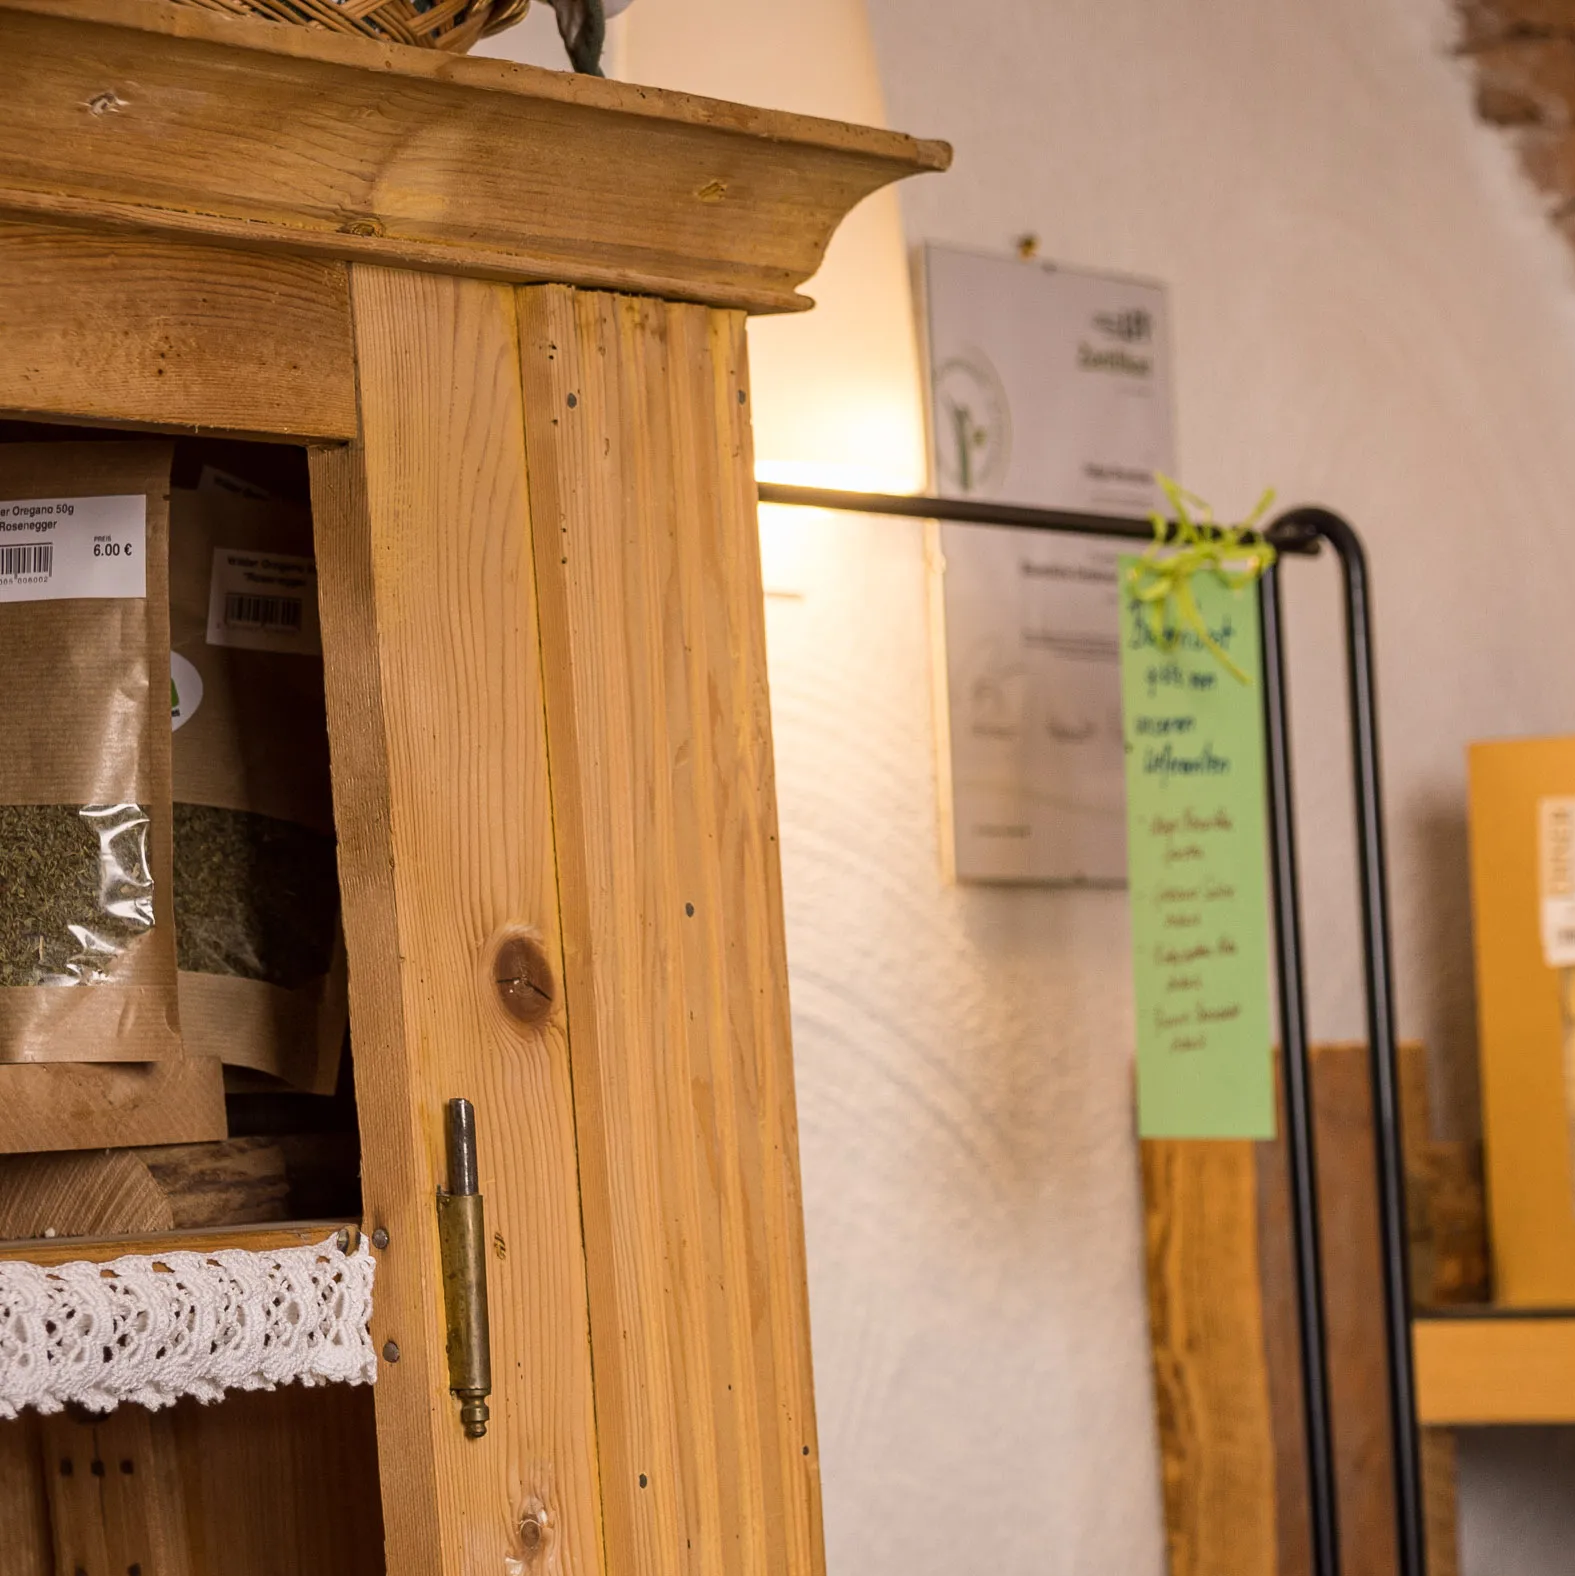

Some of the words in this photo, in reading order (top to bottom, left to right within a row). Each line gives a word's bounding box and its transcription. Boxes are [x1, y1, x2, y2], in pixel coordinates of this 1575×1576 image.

[12, 505, 54, 518] Oregano
[55, 504, 75, 516] 50g
[0, 520, 58, 533] Rosenegger
[93, 543, 121, 557] 6.00
[124, 543, 133, 556] €
